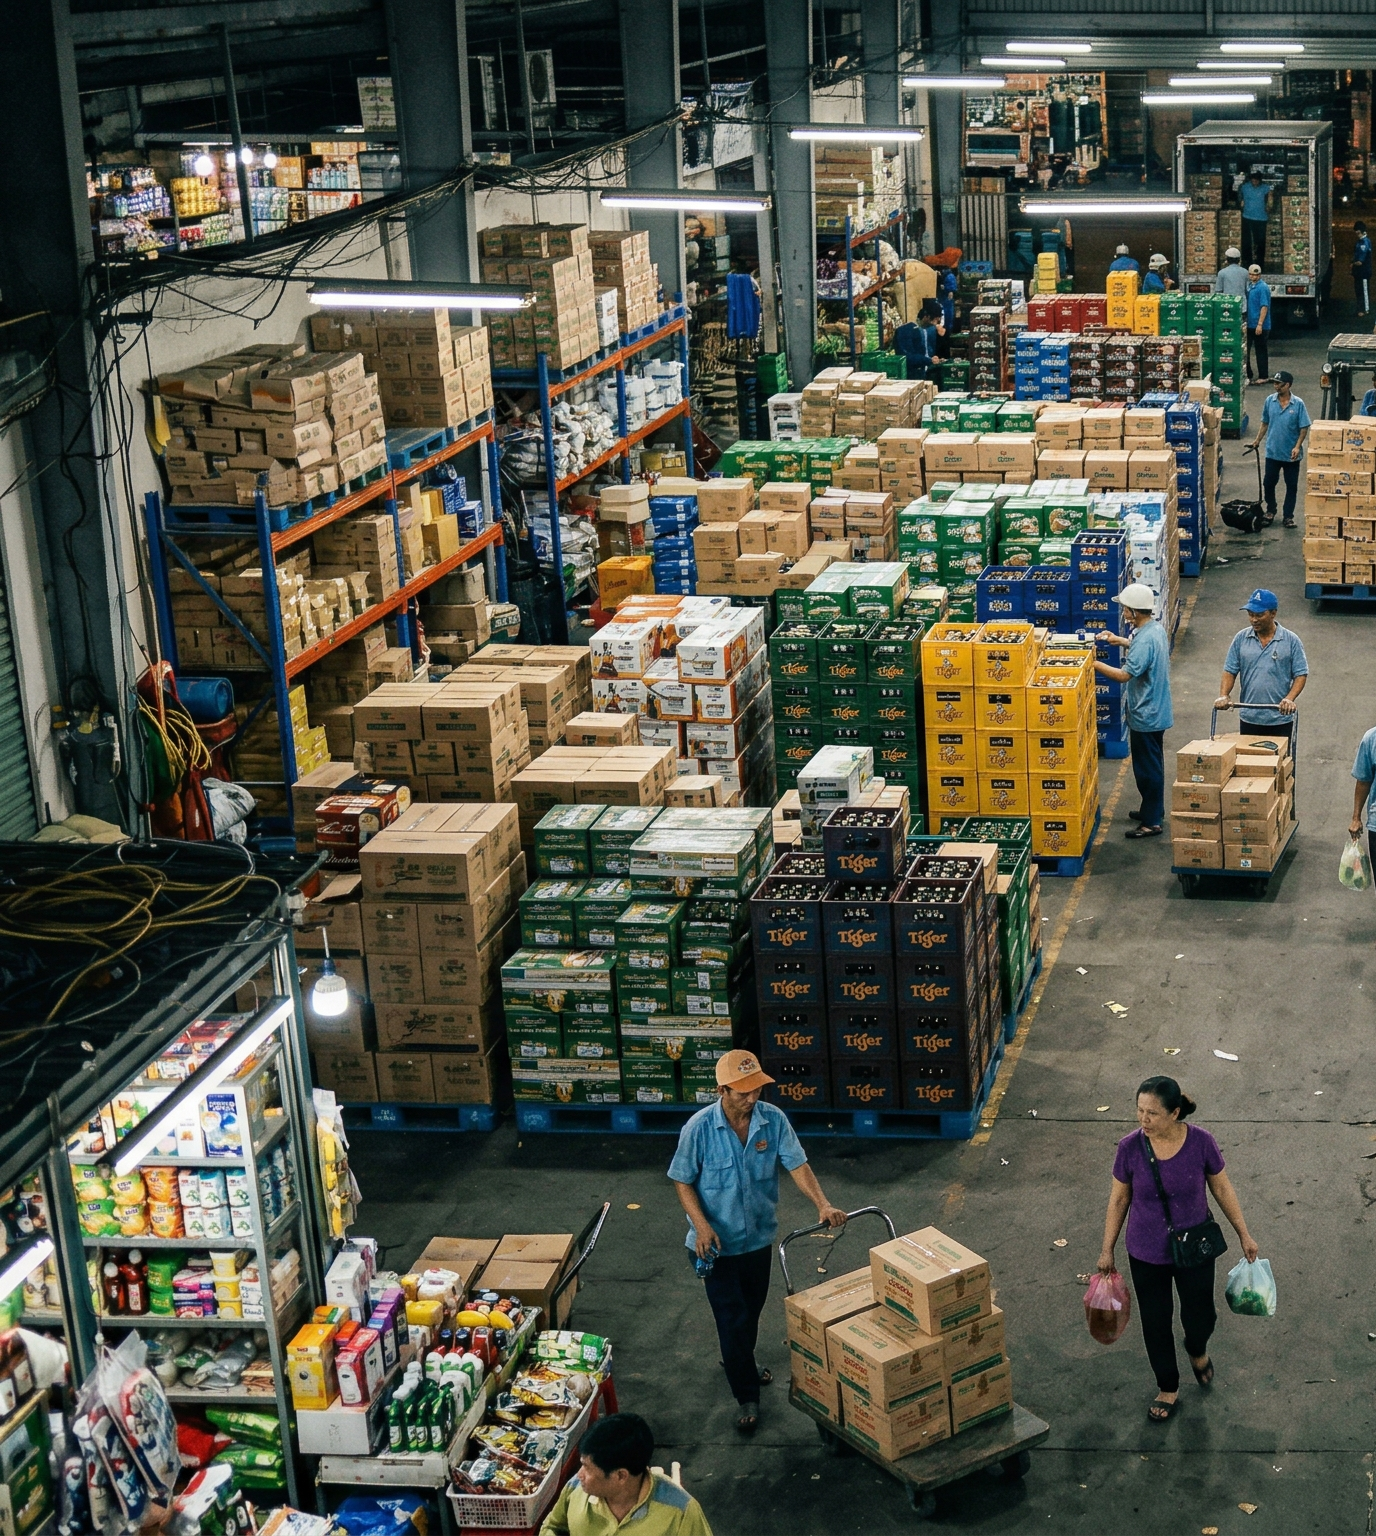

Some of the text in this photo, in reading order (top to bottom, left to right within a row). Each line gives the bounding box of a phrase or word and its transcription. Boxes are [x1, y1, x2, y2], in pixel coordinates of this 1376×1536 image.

[837, 853, 878, 873] Tiger
[767, 928, 808, 946] Tiger
[837, 929, 877, 947] Tiger
[908, 930, 948, 948] Tiger
[770, 980, 810, 998] Tiger
[840, 982, 880, 1000] Tiger
[910, 983, 950, 1001] Tiger
[774, 1032, 813, 1050] Tiger
[843, 1033, 882, 1051] Tiger
[913, 1034, 952, 1052] Tiger
[777, 1082, 817, 1100] Tiger
[846, 1083, 886, 1101] Tiger
[915, 1084, 955, 1102] Tiger
